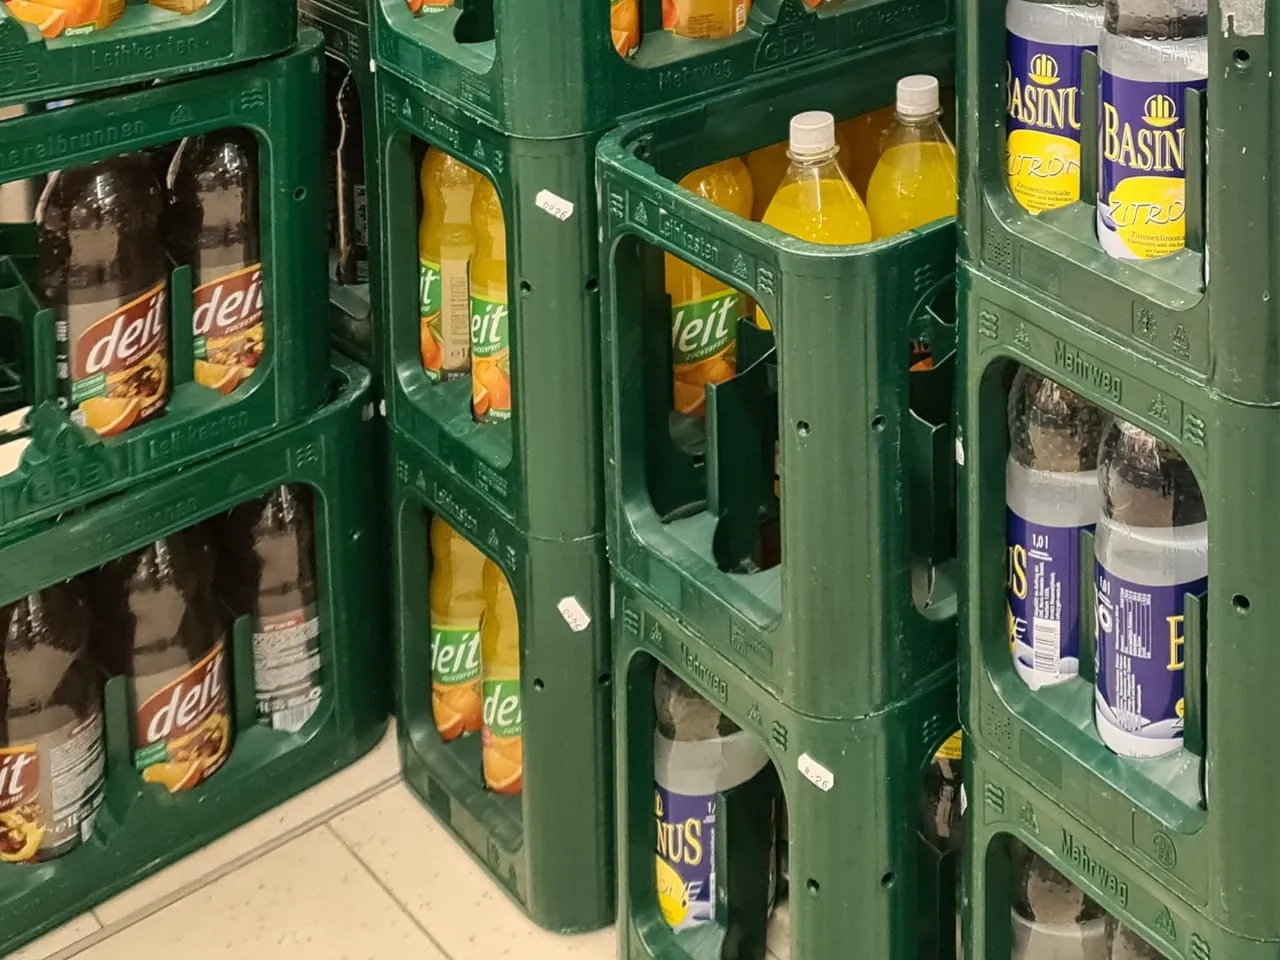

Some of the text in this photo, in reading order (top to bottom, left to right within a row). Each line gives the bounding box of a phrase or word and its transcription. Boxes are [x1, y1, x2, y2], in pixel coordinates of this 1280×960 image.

[658, 57, 733, 90] Mehrweg
[1103, 101, 1185, 172] BASIN
[659, 216, 719, 263] Leihkasten
[1107, 200, 1185, 229] ZITRO
[86, 294, 164, 374] deit
[471, 305, 508, 344] eit
[1053, 339, 1123, 398] Mehrweg
[147, 655, 223, 742] deit
[680, 642, 729, 705] Mehrweg
[484, 685, 522, 725] dei
[0, 753, 36, 797] it
[1061, 828, 1128, 909] Mehrweg
